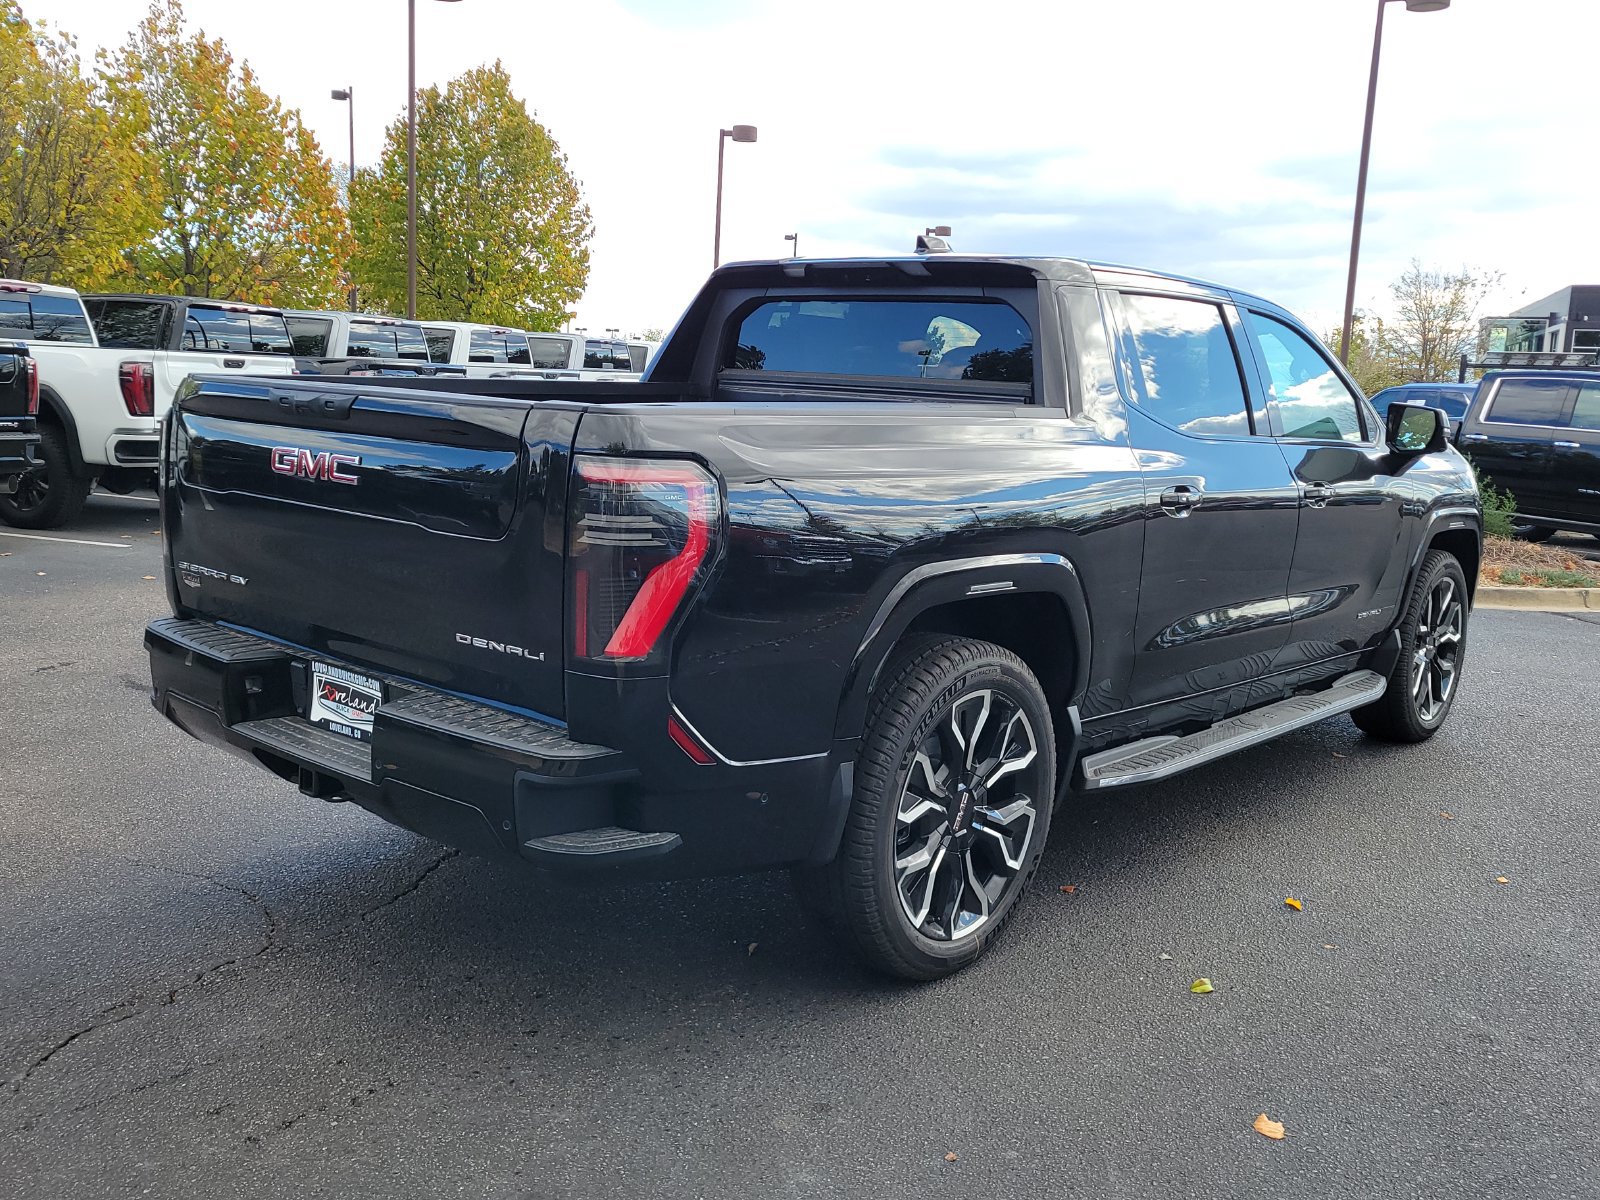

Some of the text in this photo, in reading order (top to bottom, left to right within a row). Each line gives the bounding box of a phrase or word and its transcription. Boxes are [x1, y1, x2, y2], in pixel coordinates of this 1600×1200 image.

[271, 446, 361, 485] GMC
[178, 561, 228, 580] SIERRA
[230, 575, 249, 585] EV
[455, 633, 545, 662] DENALI
[351, 709, 364, 719] GMC
[912, 677, 966, 746] MICHELIN
[354, 729, 361, 739] CO
